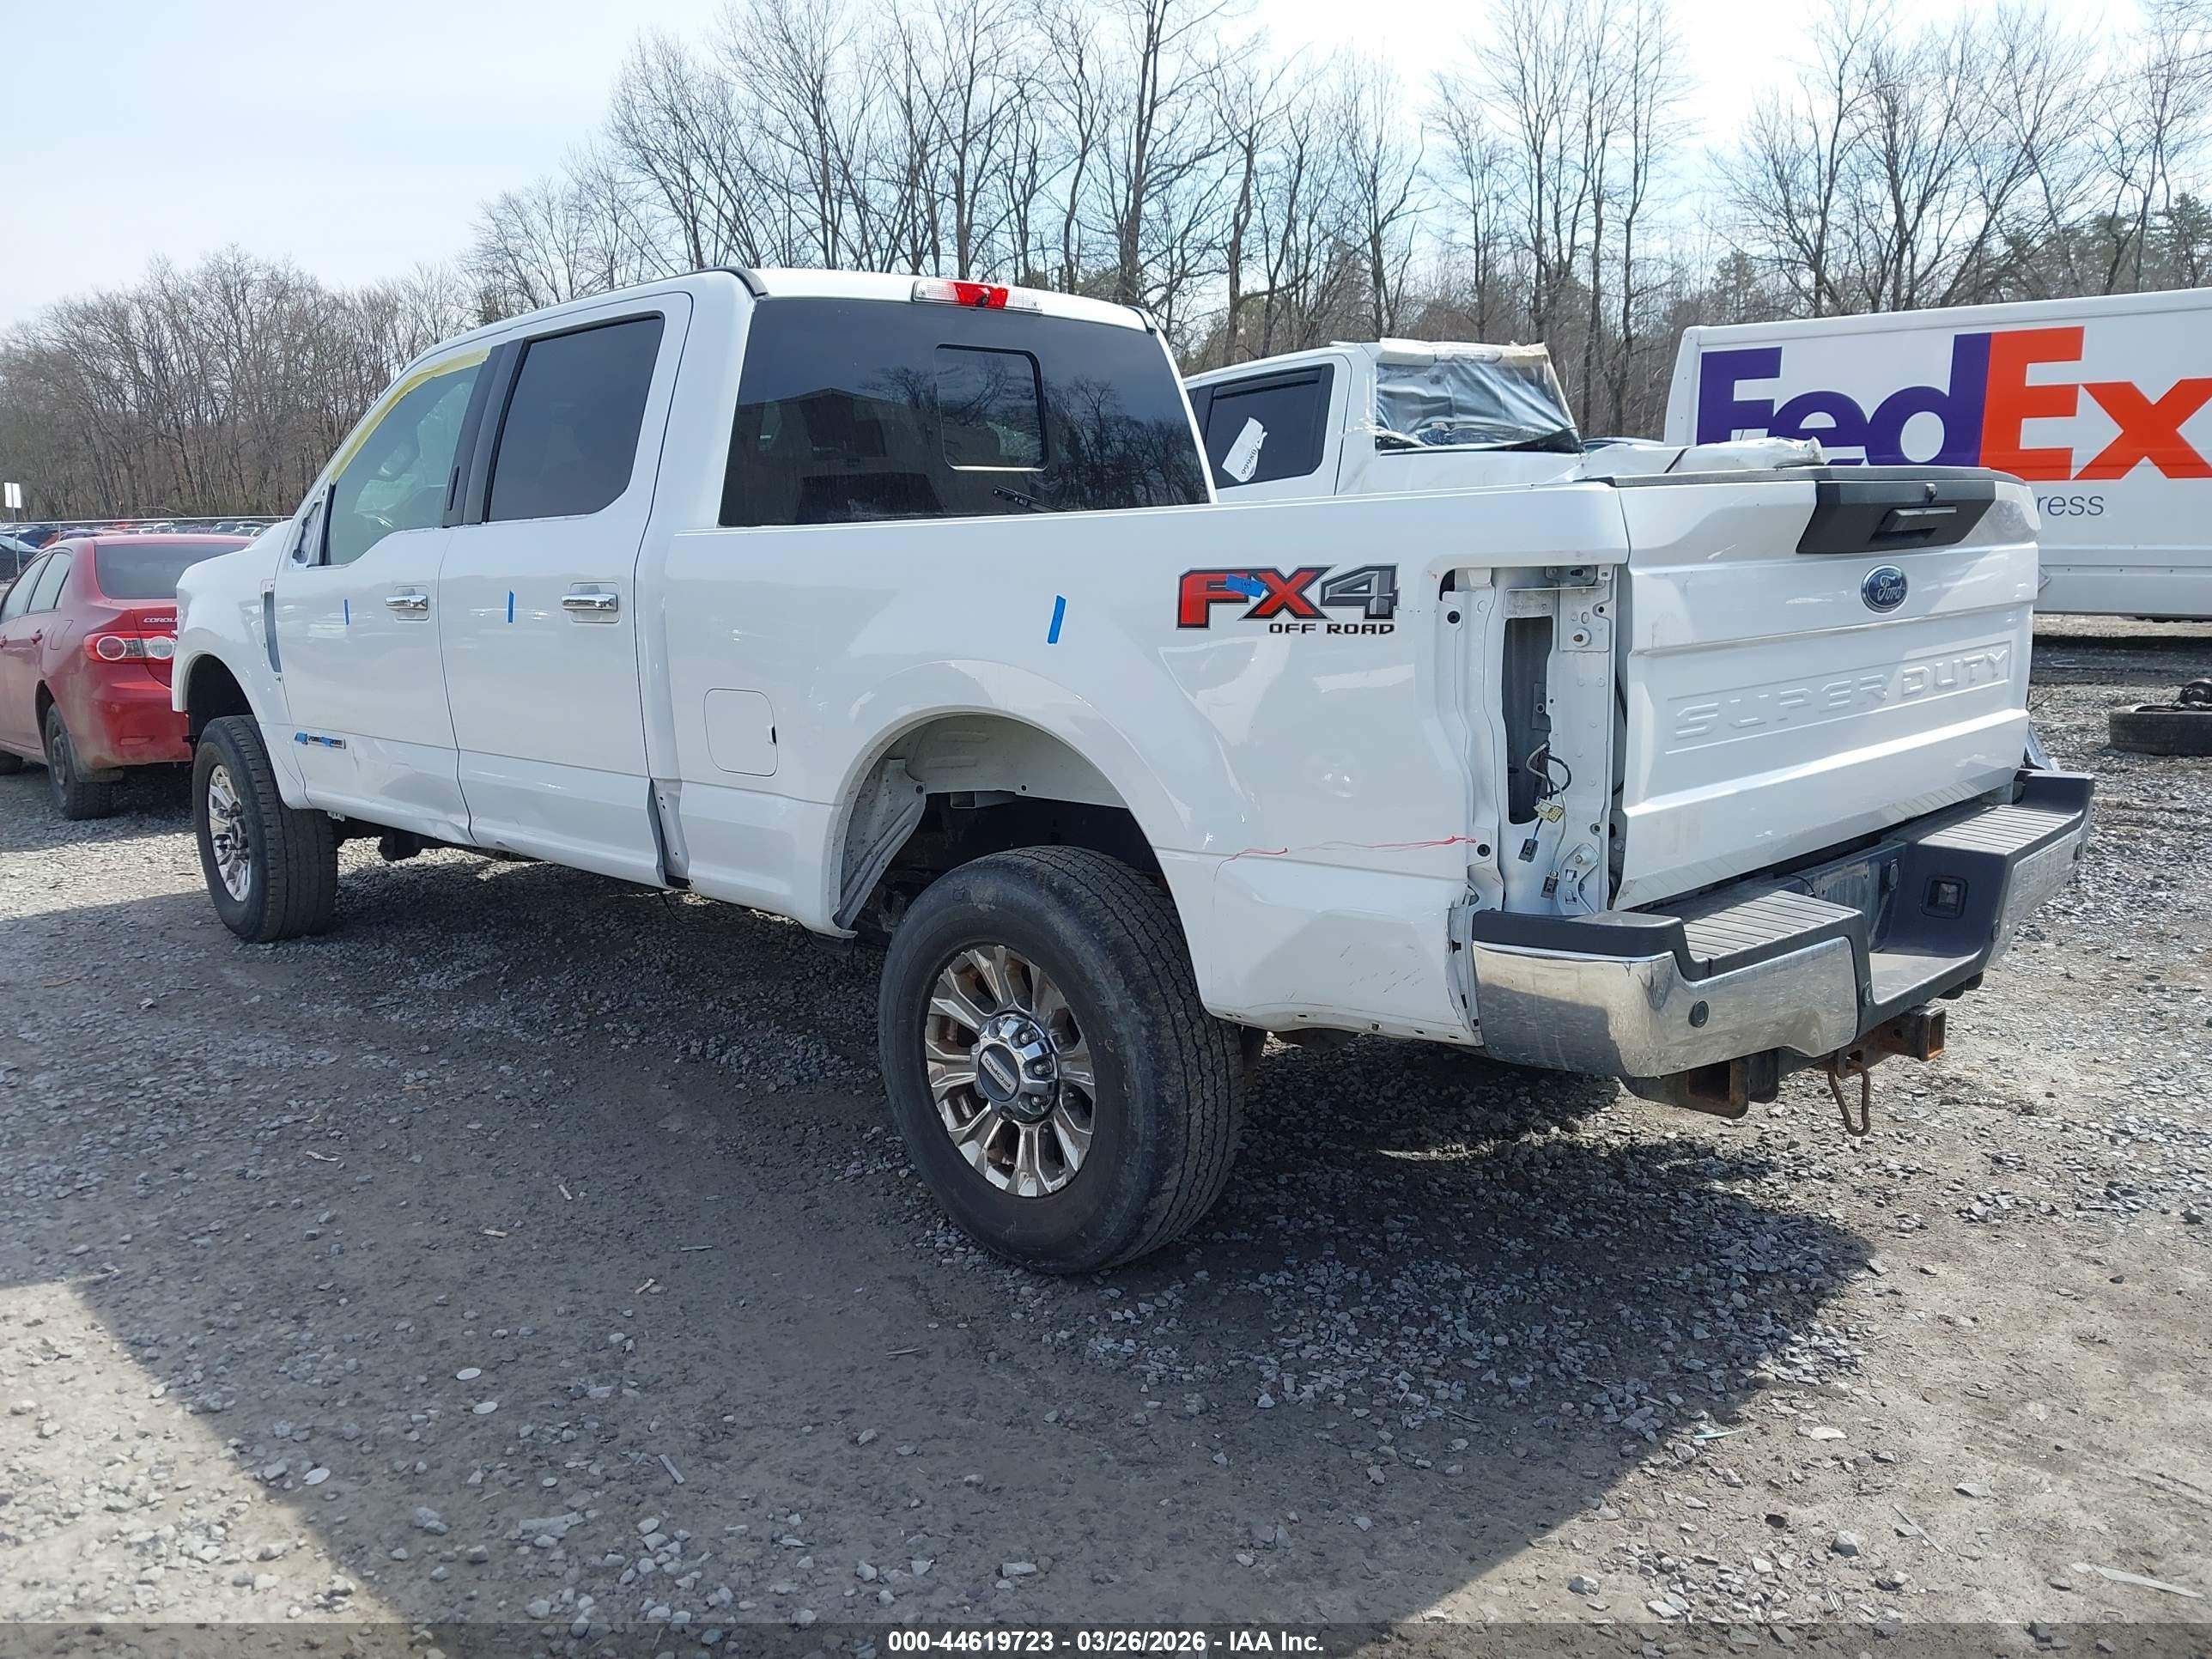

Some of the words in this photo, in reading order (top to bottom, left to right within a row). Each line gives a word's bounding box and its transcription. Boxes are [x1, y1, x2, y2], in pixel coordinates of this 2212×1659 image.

[1696, 325, 2212, 482] FedEx
[2037, 495, 2104, 516] ress
[1176, 563, 1400, 630] FX4
[1876, 574, 1905, 602] Ford
[1269, 623, 1316, 634] OFF
[1326, 623, 1395, 635] ROAD
[1676, 672, 1888, 741] SUPER
[1901, 648, 2008, 697] DUTY
[984, 1057, 1012, 1088] FORD
